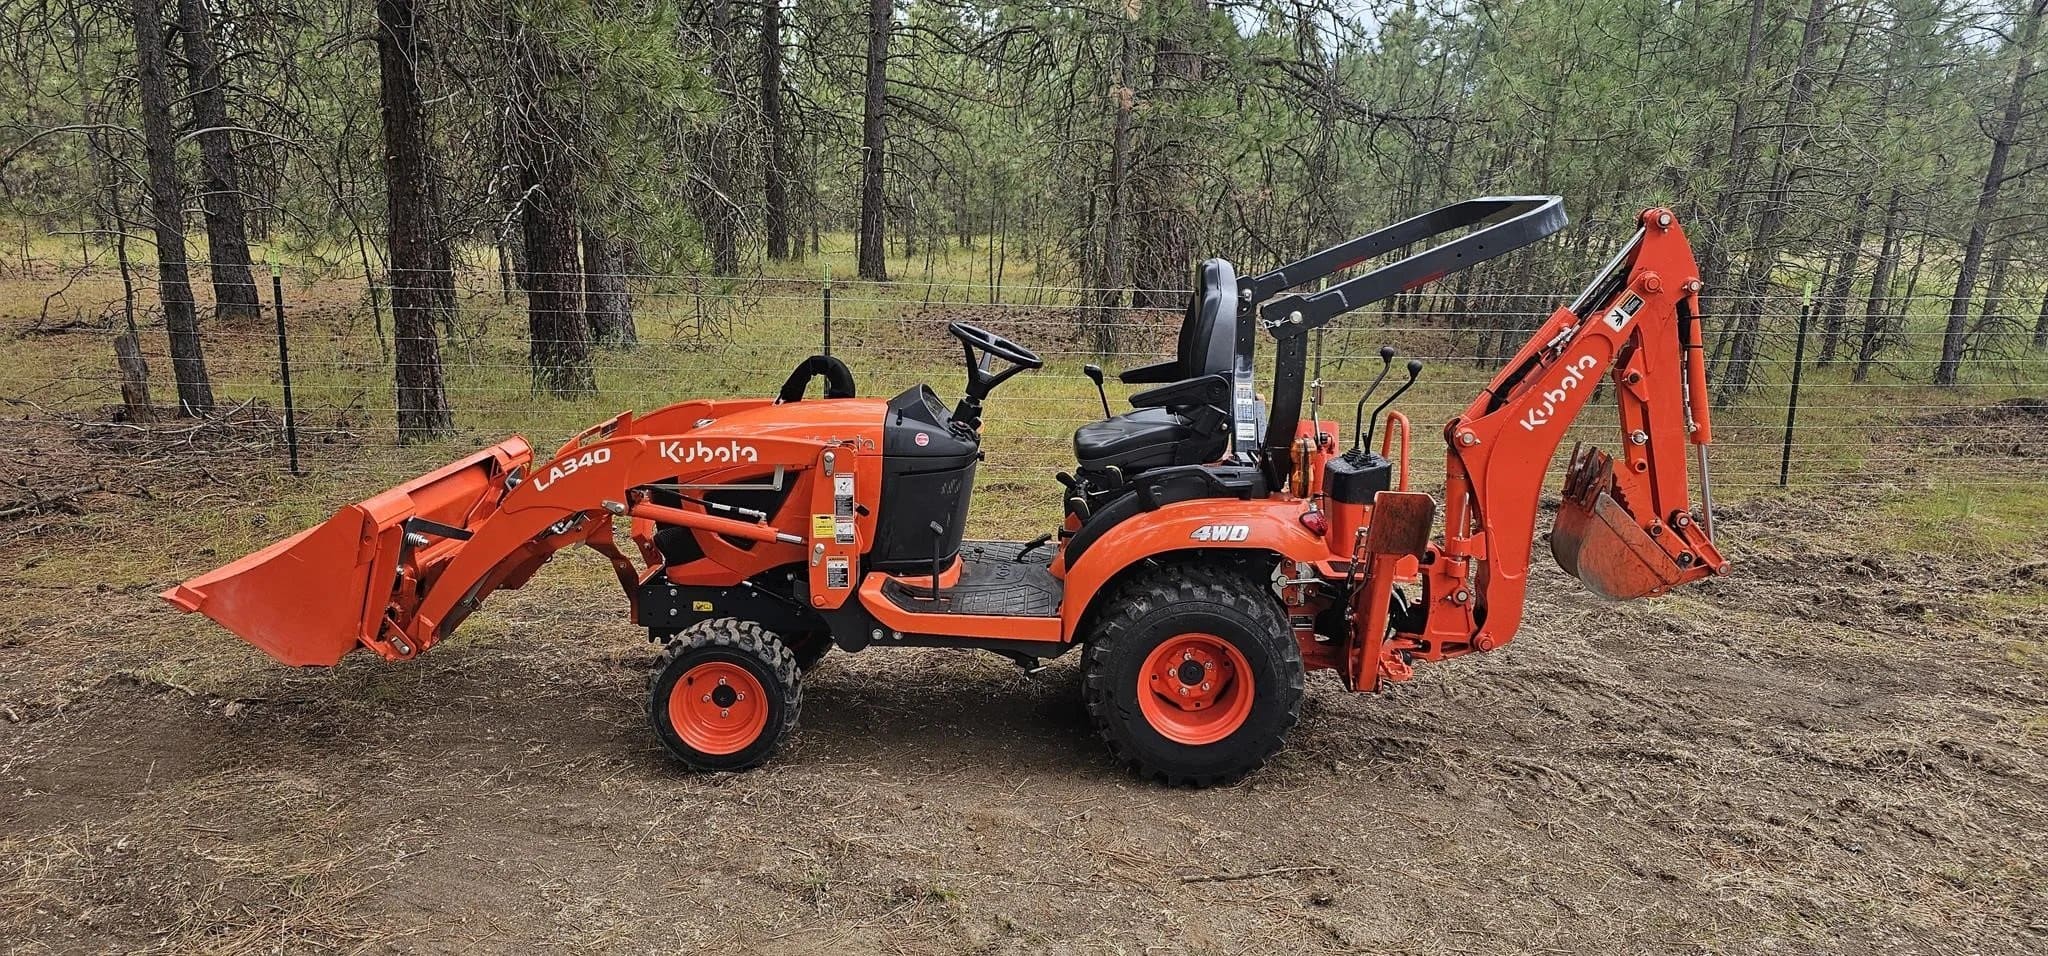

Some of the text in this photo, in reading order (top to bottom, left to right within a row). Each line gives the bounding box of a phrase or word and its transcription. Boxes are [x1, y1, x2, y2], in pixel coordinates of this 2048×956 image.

[1520, 355, 1597, 431] Kubota
[660, 441, 757, 463] Kubota
[533, 448, 611, 491] LA340
[1189, 525, 1250, 542] 4WD
